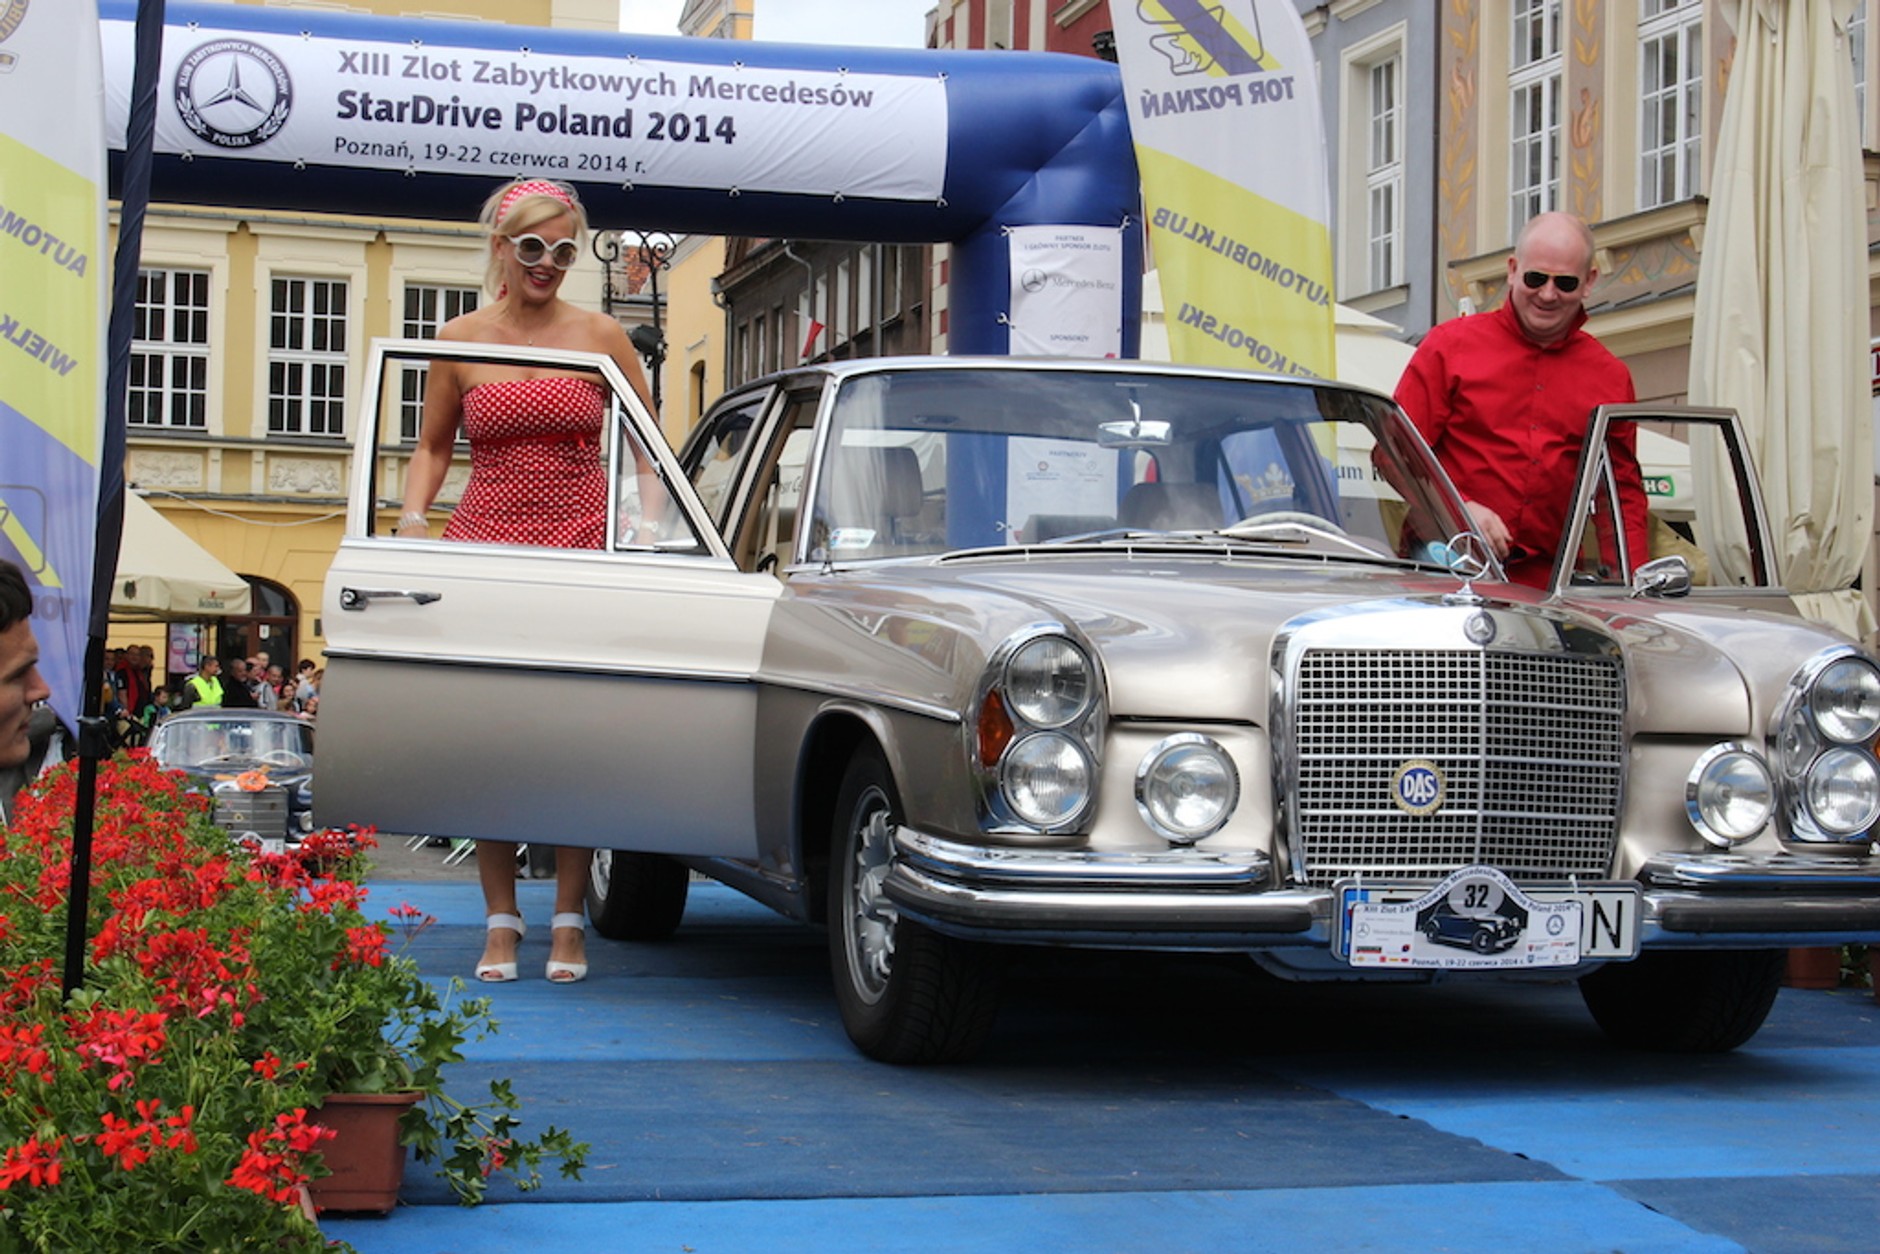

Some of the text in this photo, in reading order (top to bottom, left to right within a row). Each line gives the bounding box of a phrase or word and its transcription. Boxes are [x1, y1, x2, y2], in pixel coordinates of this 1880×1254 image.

[338, 50, 874, 108] XIII Zlot Zabytkowych Mercedesów
[336, 89, 737, 145] StarDrive Poland 2014
[212, 133, 251, 146] POLSKA
[334, 136, 647, 174] Poznań, 19-22 czerwca 2014 r.
[1404, 773, 1436, 803] DAS
[1464, 884, 1489, 909] 32
[1591, 900, 1622, 949] N
